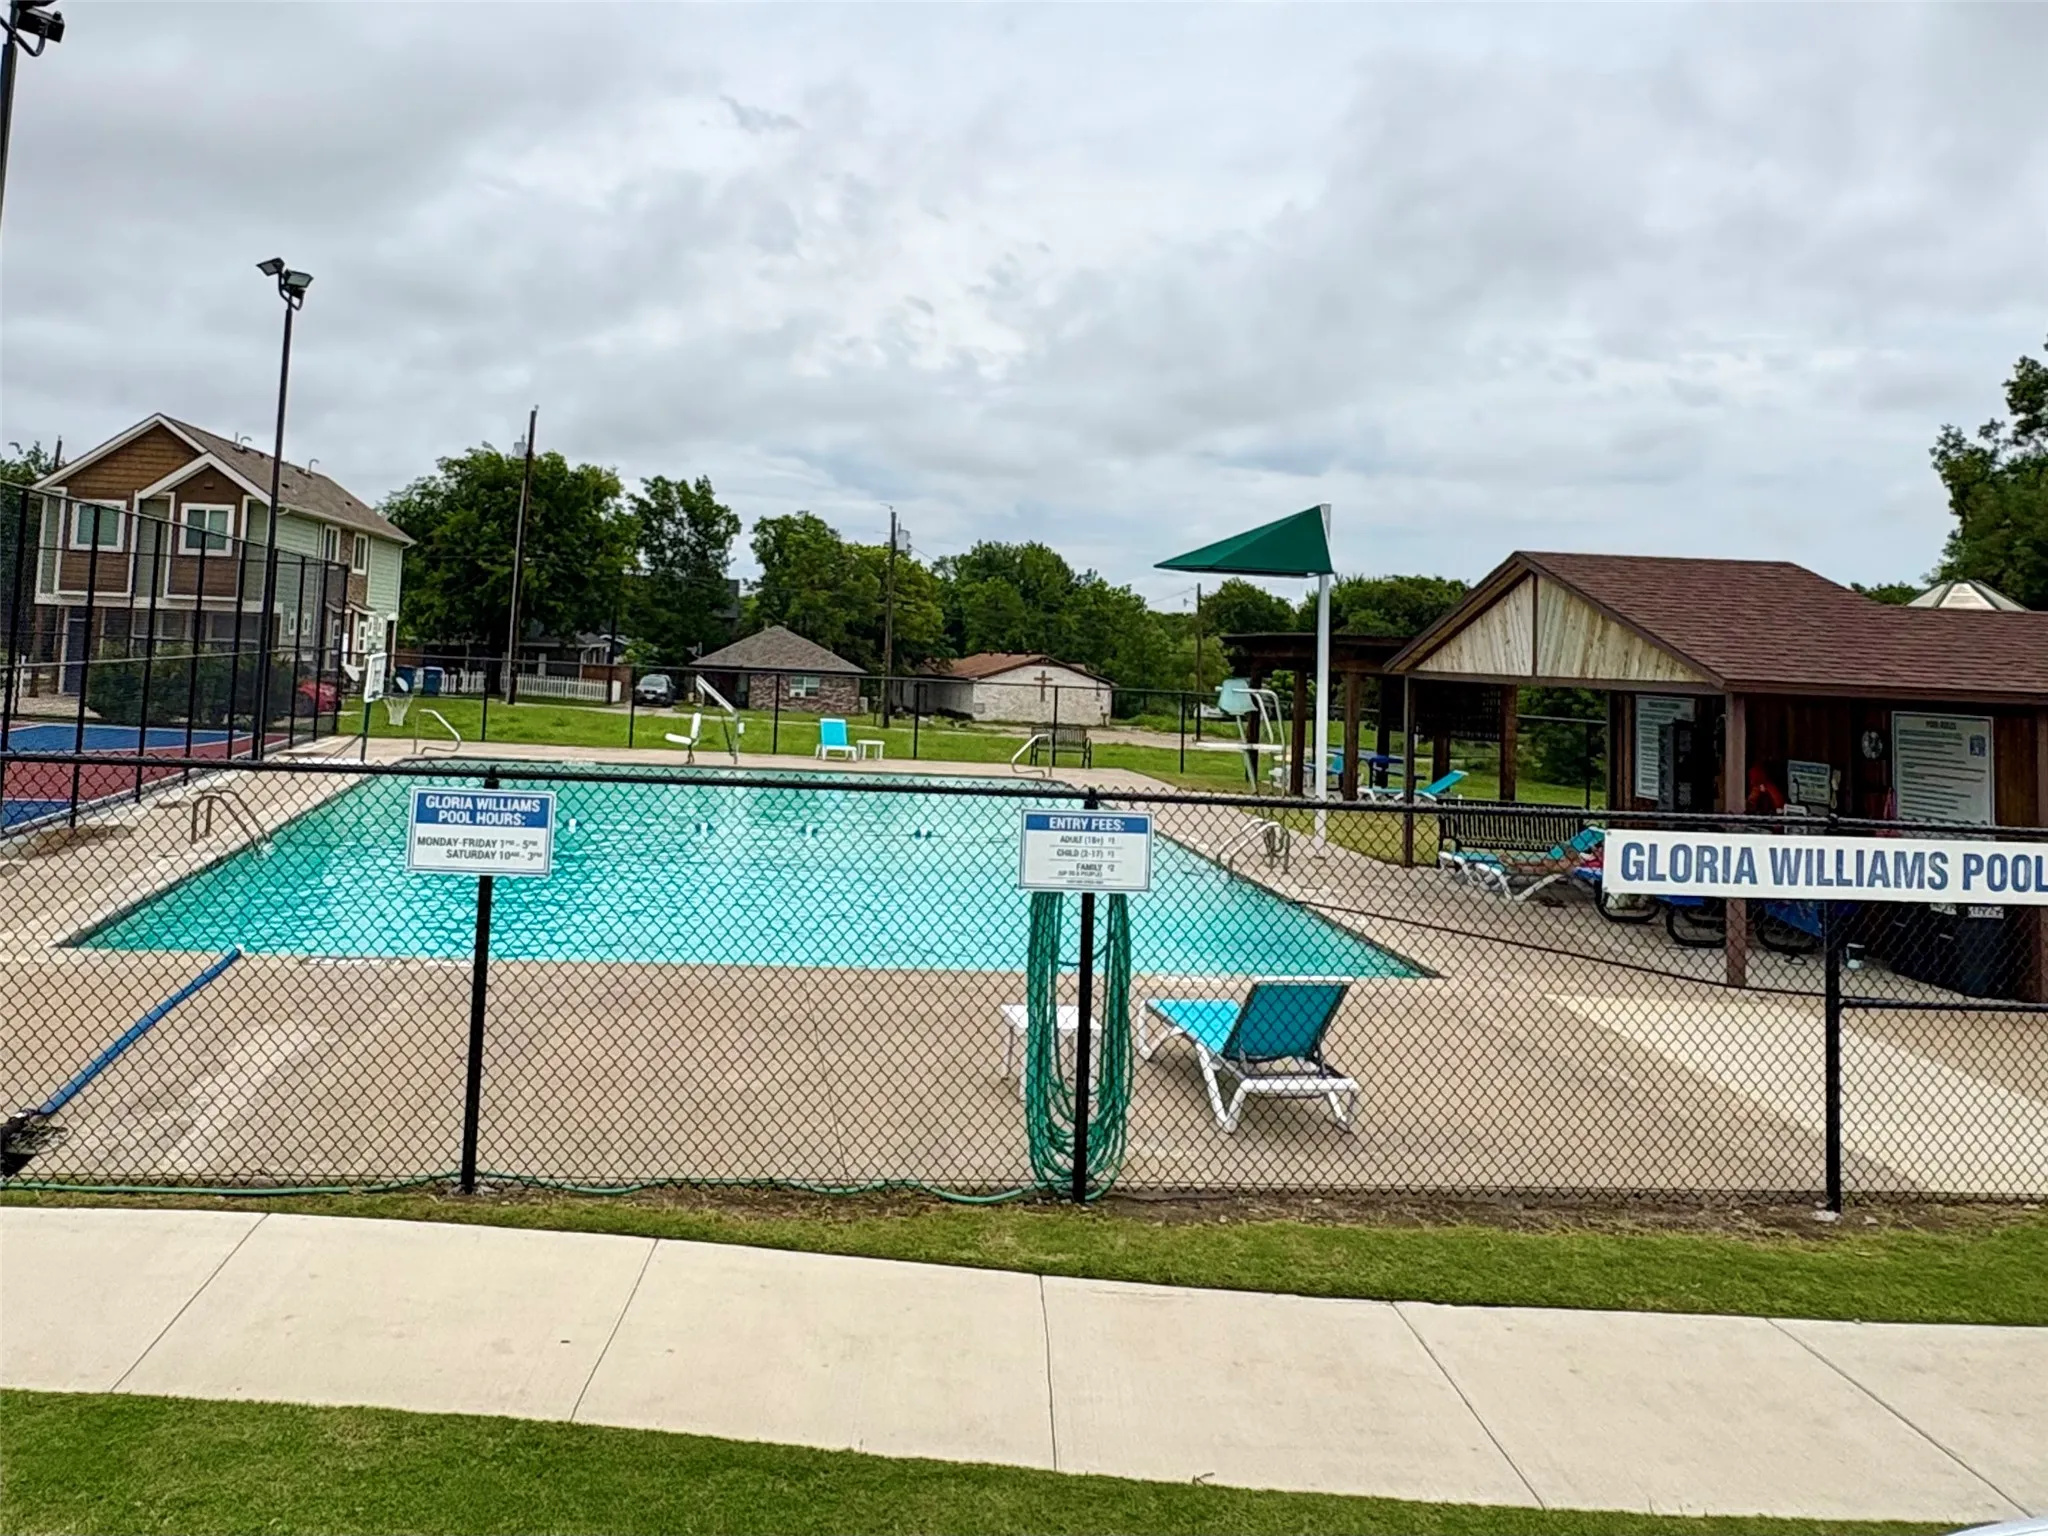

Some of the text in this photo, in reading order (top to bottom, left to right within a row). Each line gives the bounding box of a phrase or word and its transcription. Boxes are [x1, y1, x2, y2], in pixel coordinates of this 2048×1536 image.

[426, 795, 541, 812] GLORIA WILLIAMS
[438, 811, 526, 825] POOL HOURS:
[1049, 817, 1126, 832] ENTRY FEES:
[1060, 835, 1083, 844] ADULT
[446, 849, 497, 860] SATURDAY
[1056, 849, 1079, 857] CHILD
[1076, 863, 1103, 871] FAMILY
[1621, 842, 2048, 893] GLORIA WILLIAMS POOL
